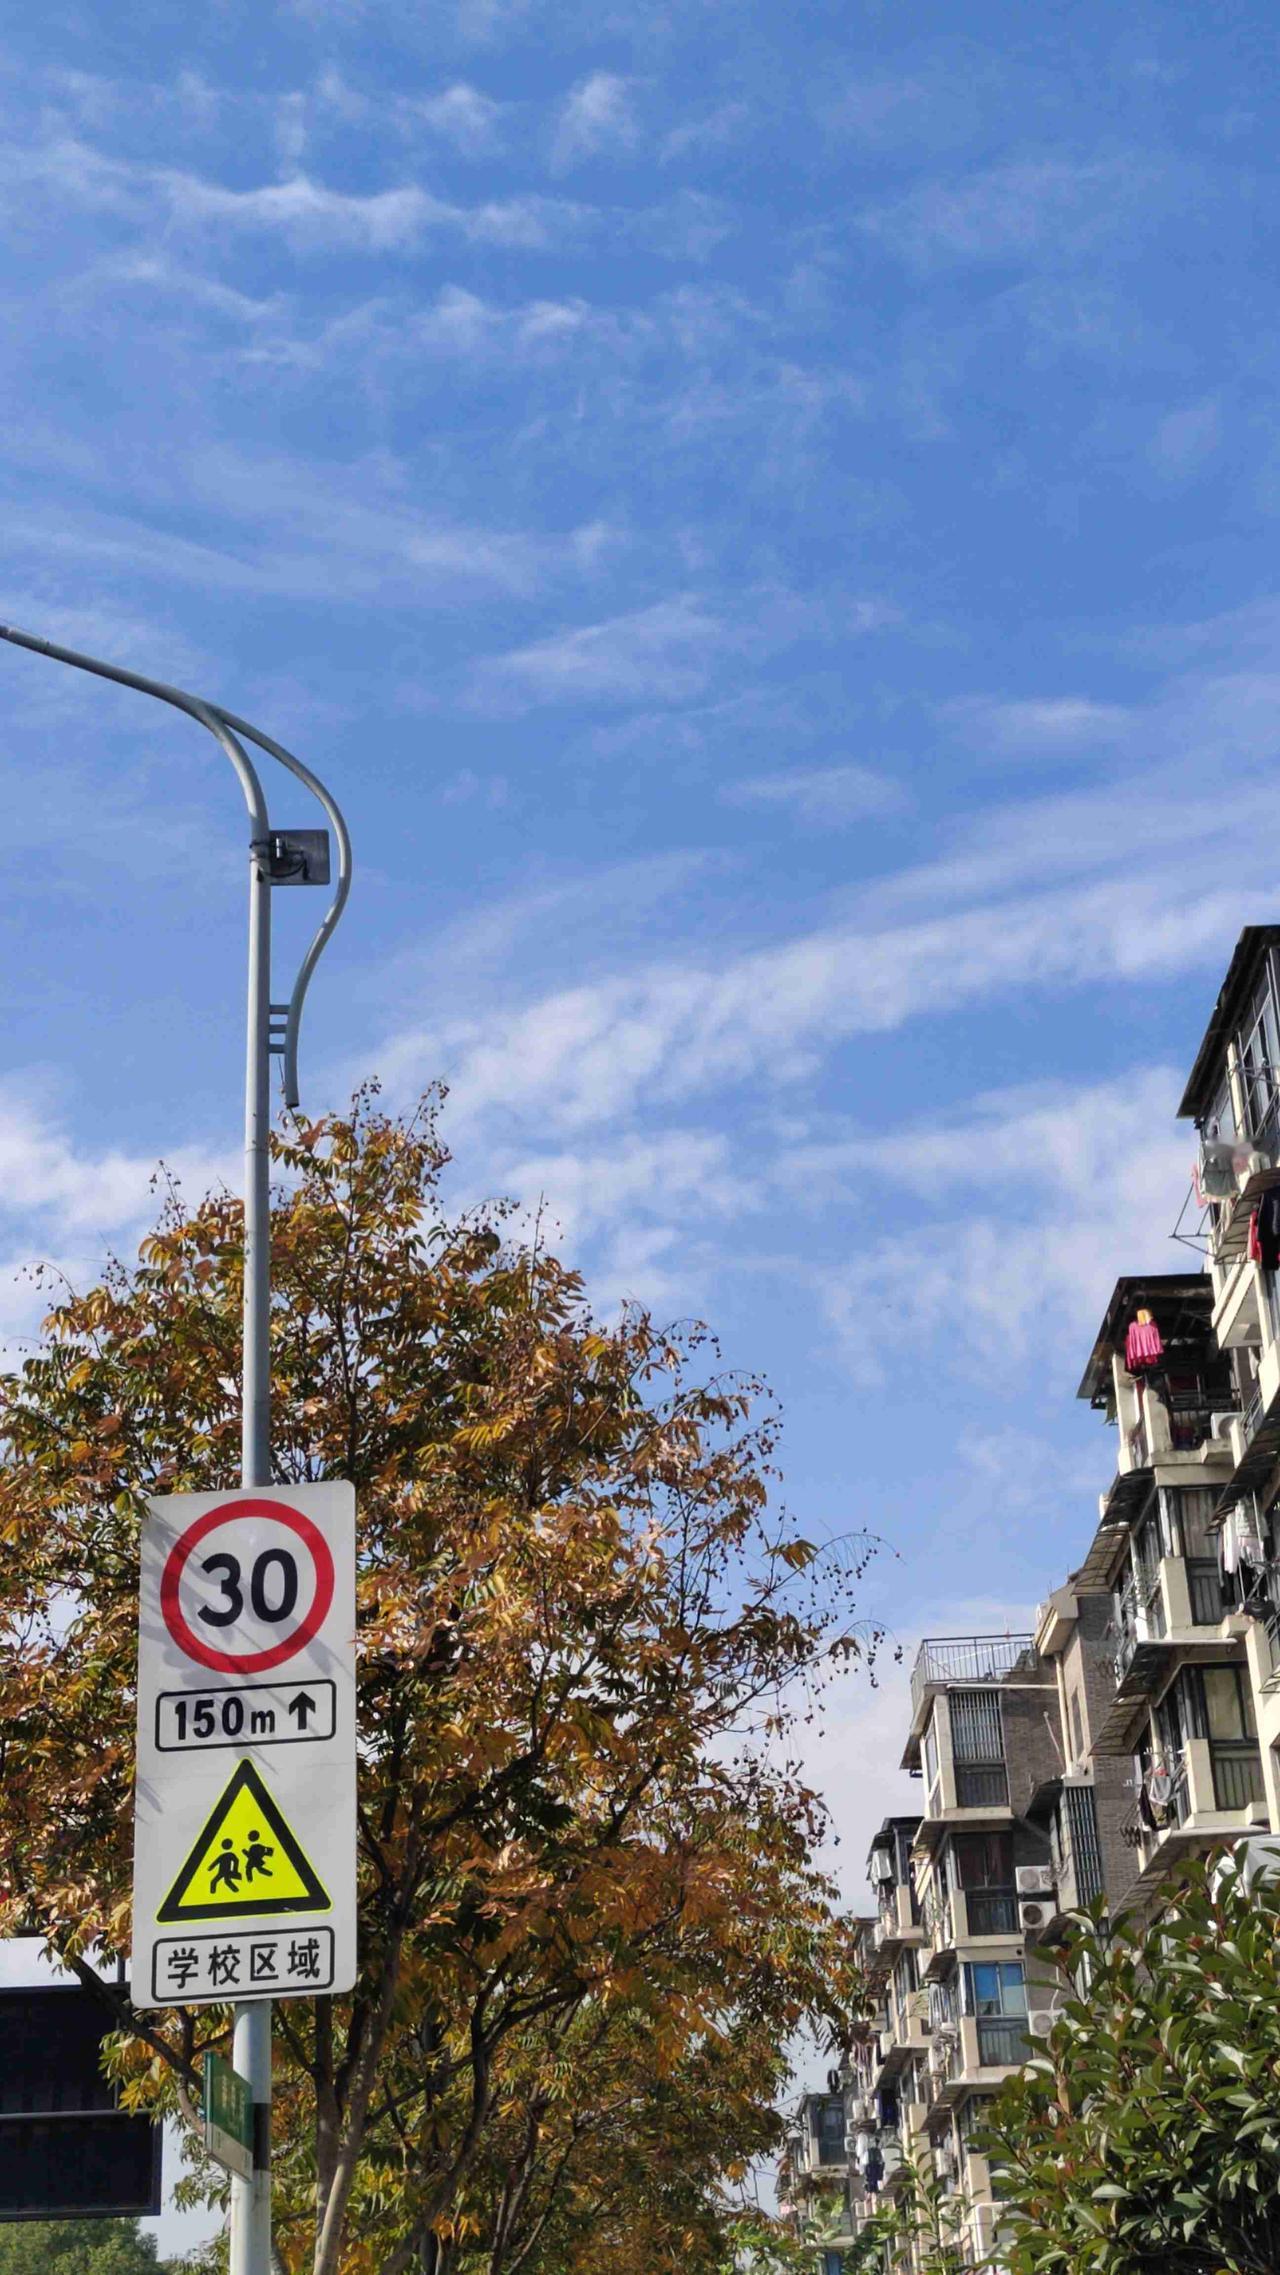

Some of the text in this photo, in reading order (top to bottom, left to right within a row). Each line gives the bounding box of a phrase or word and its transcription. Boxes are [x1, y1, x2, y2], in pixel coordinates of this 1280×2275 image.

[197, 1548, 298, 1627] 30
[175, 1696, 275, 1740] 150m
[167, 1938, 320, 1989] 学校区域
